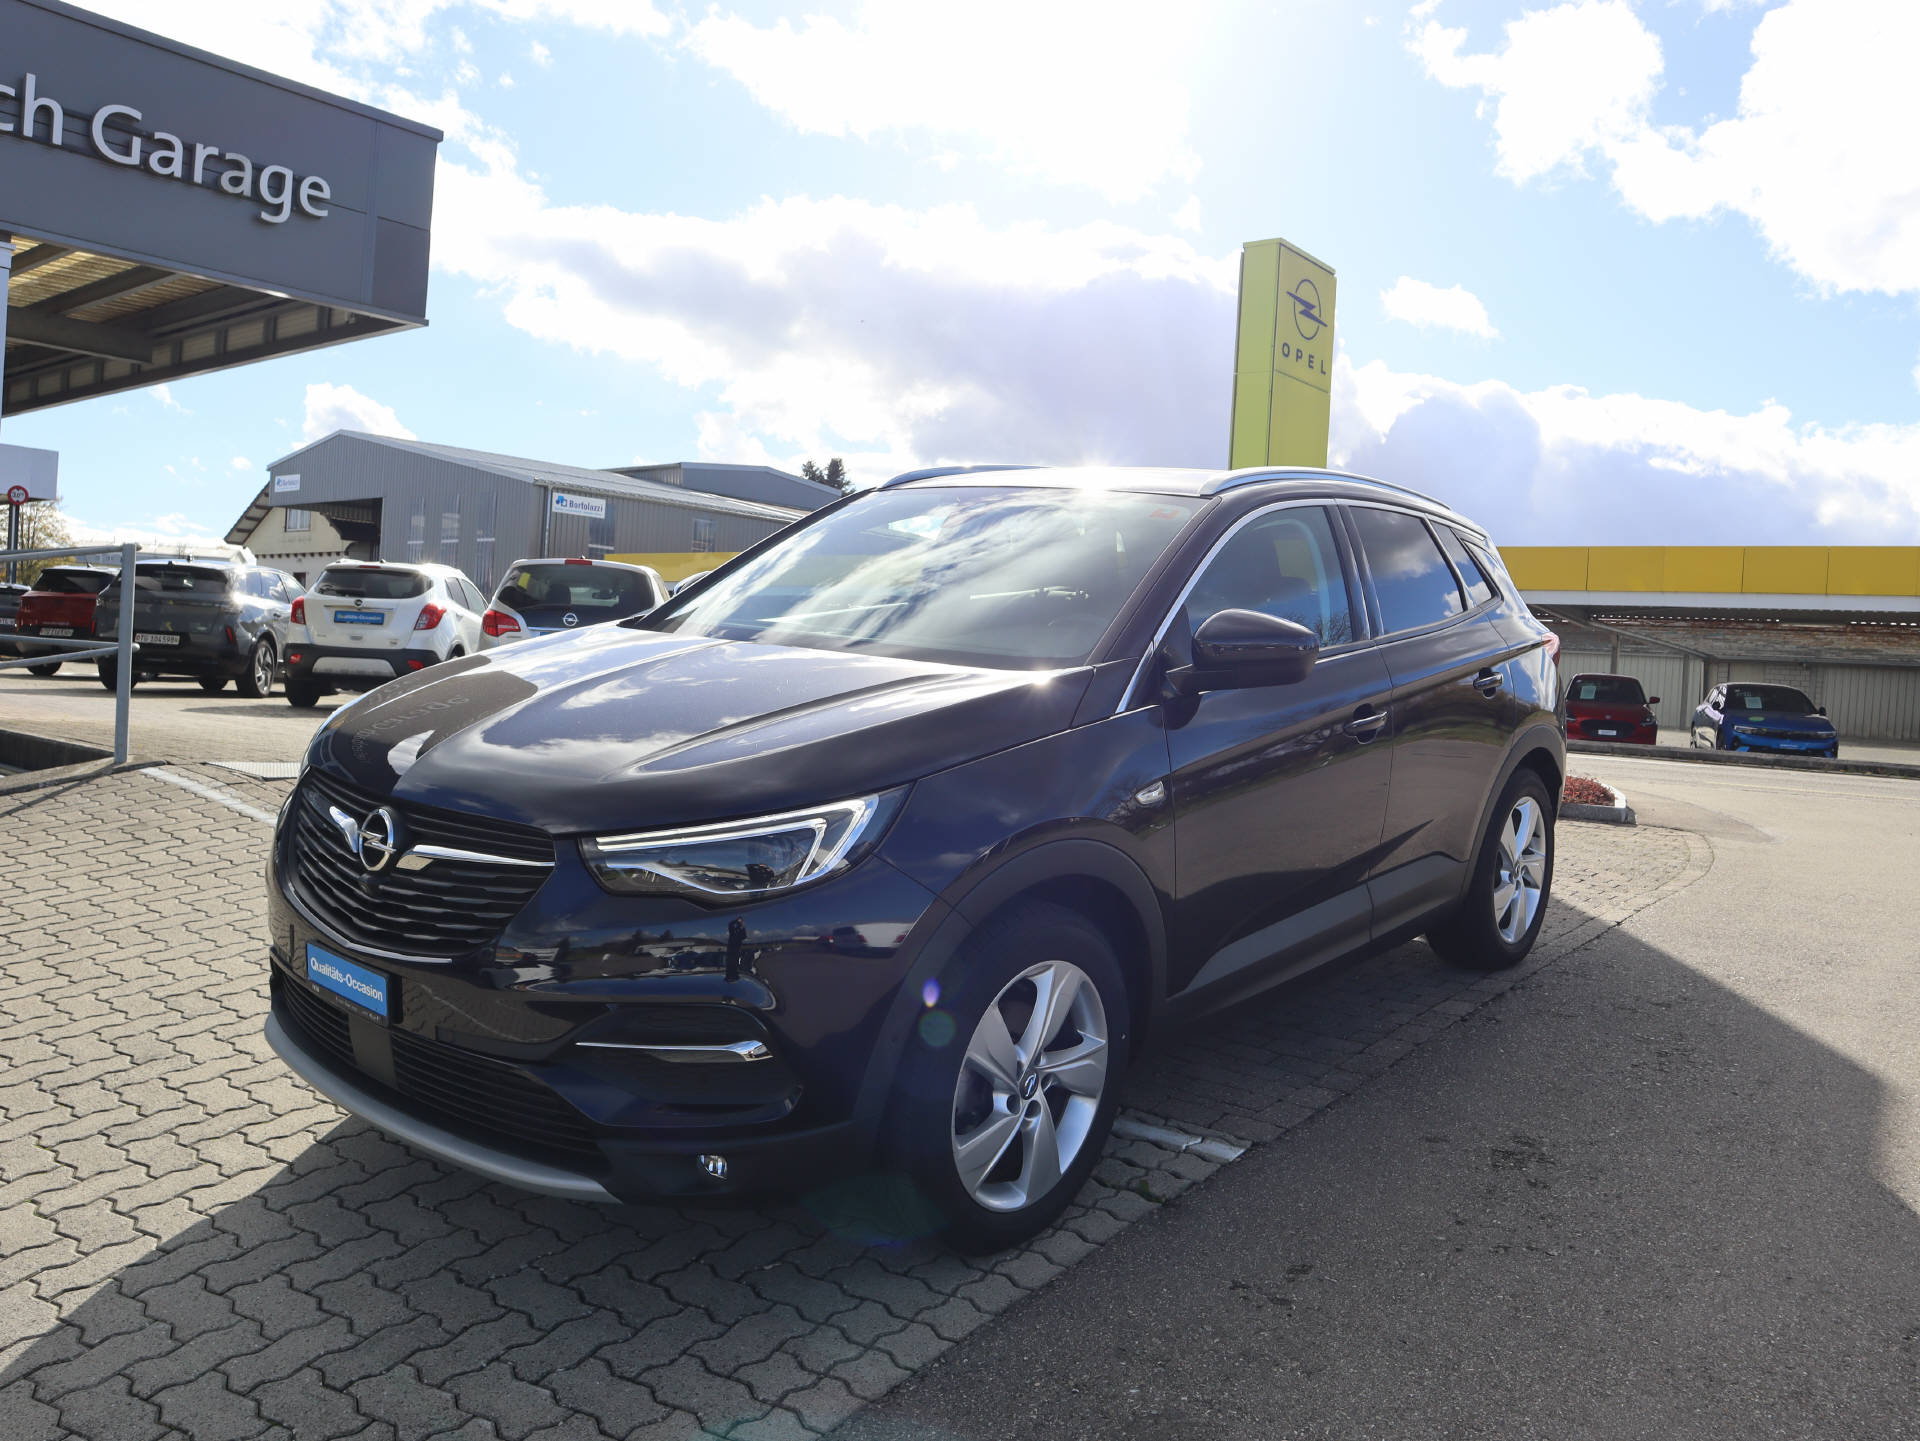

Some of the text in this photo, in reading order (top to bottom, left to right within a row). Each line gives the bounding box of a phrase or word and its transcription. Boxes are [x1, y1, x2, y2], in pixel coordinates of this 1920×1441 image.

[90, 103, 332, 224] Garage
[1281, 342, 1327, 376] OPEL
[569, 499, 603, 513] Bortolazzi
[310, 956, 384, 1003] Qualitäts-Occasion
